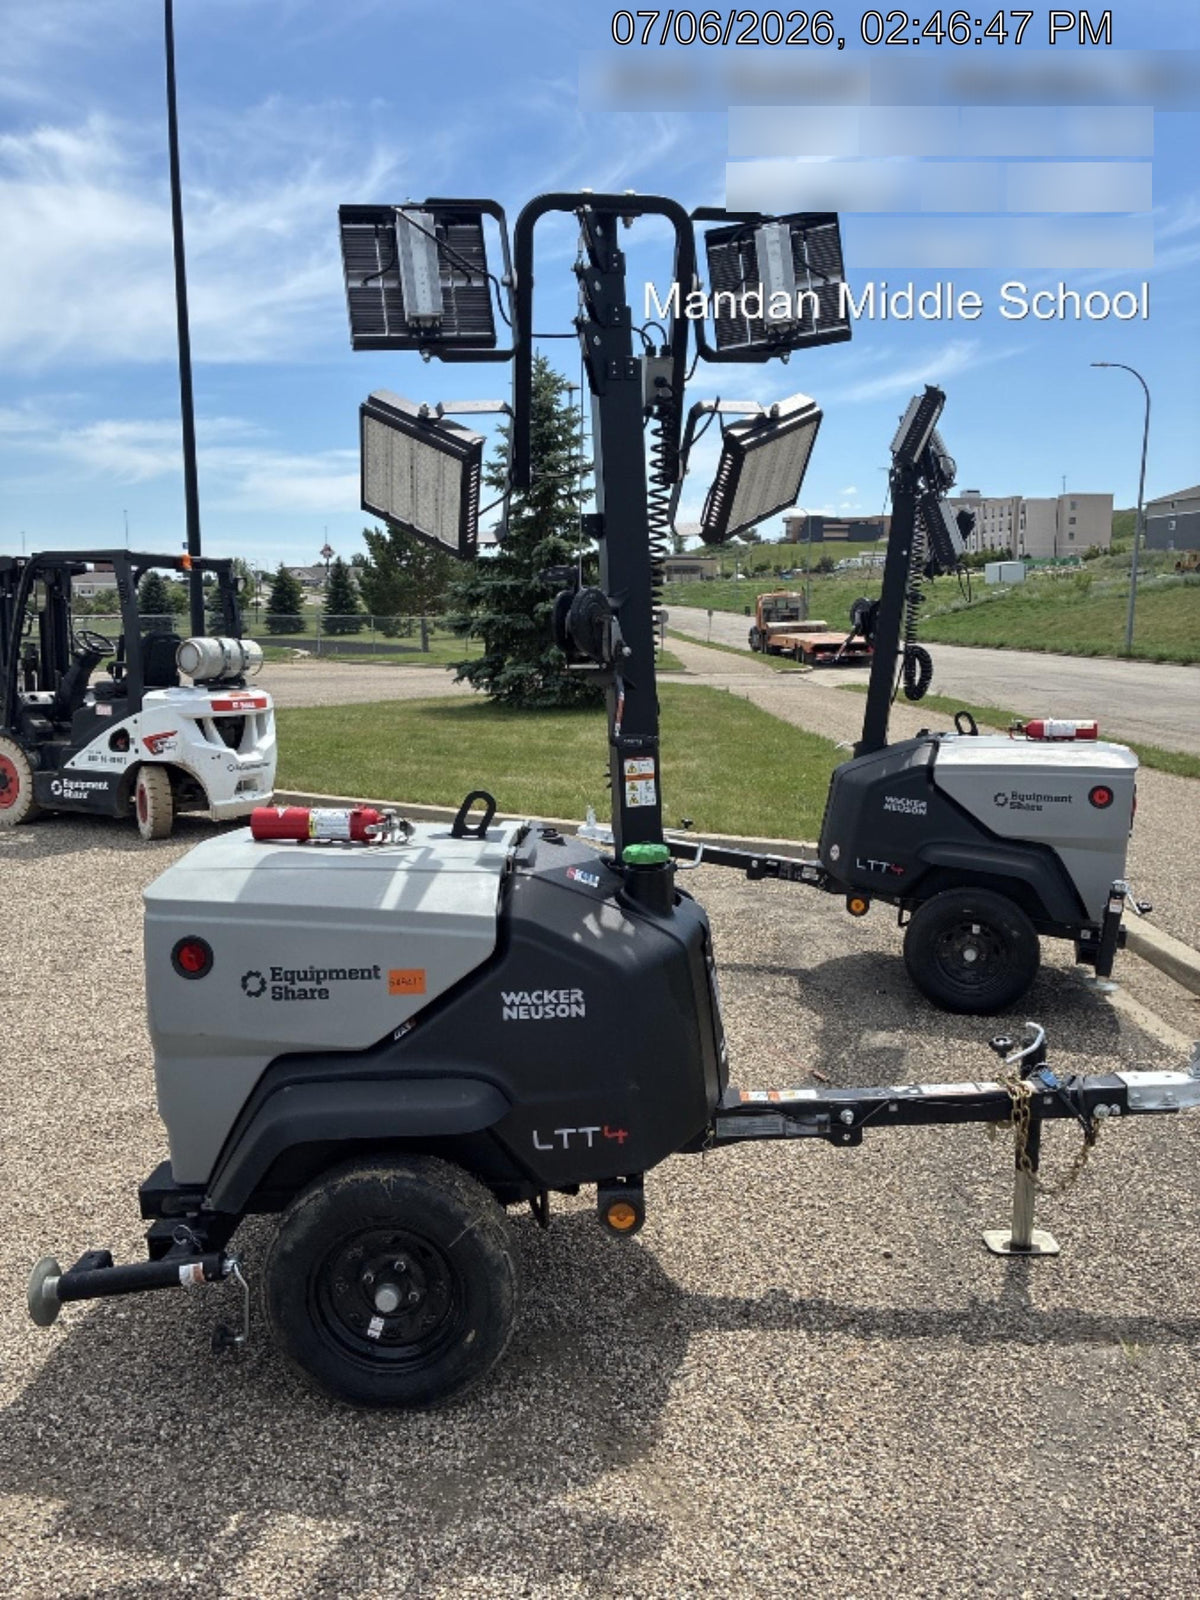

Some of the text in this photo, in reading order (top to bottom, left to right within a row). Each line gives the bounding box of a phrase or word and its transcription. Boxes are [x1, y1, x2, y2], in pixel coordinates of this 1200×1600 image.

[1011, 790, 1072, 803] Equipment
[269, 964, 381, 985] Equipment
[271, 985, 330, 1001] Share
[501, 988, 584, 1005] WACKER
[502, 1004, 586, 1021] NEUSON
[532, 1125, 628, 1150] LTT4
